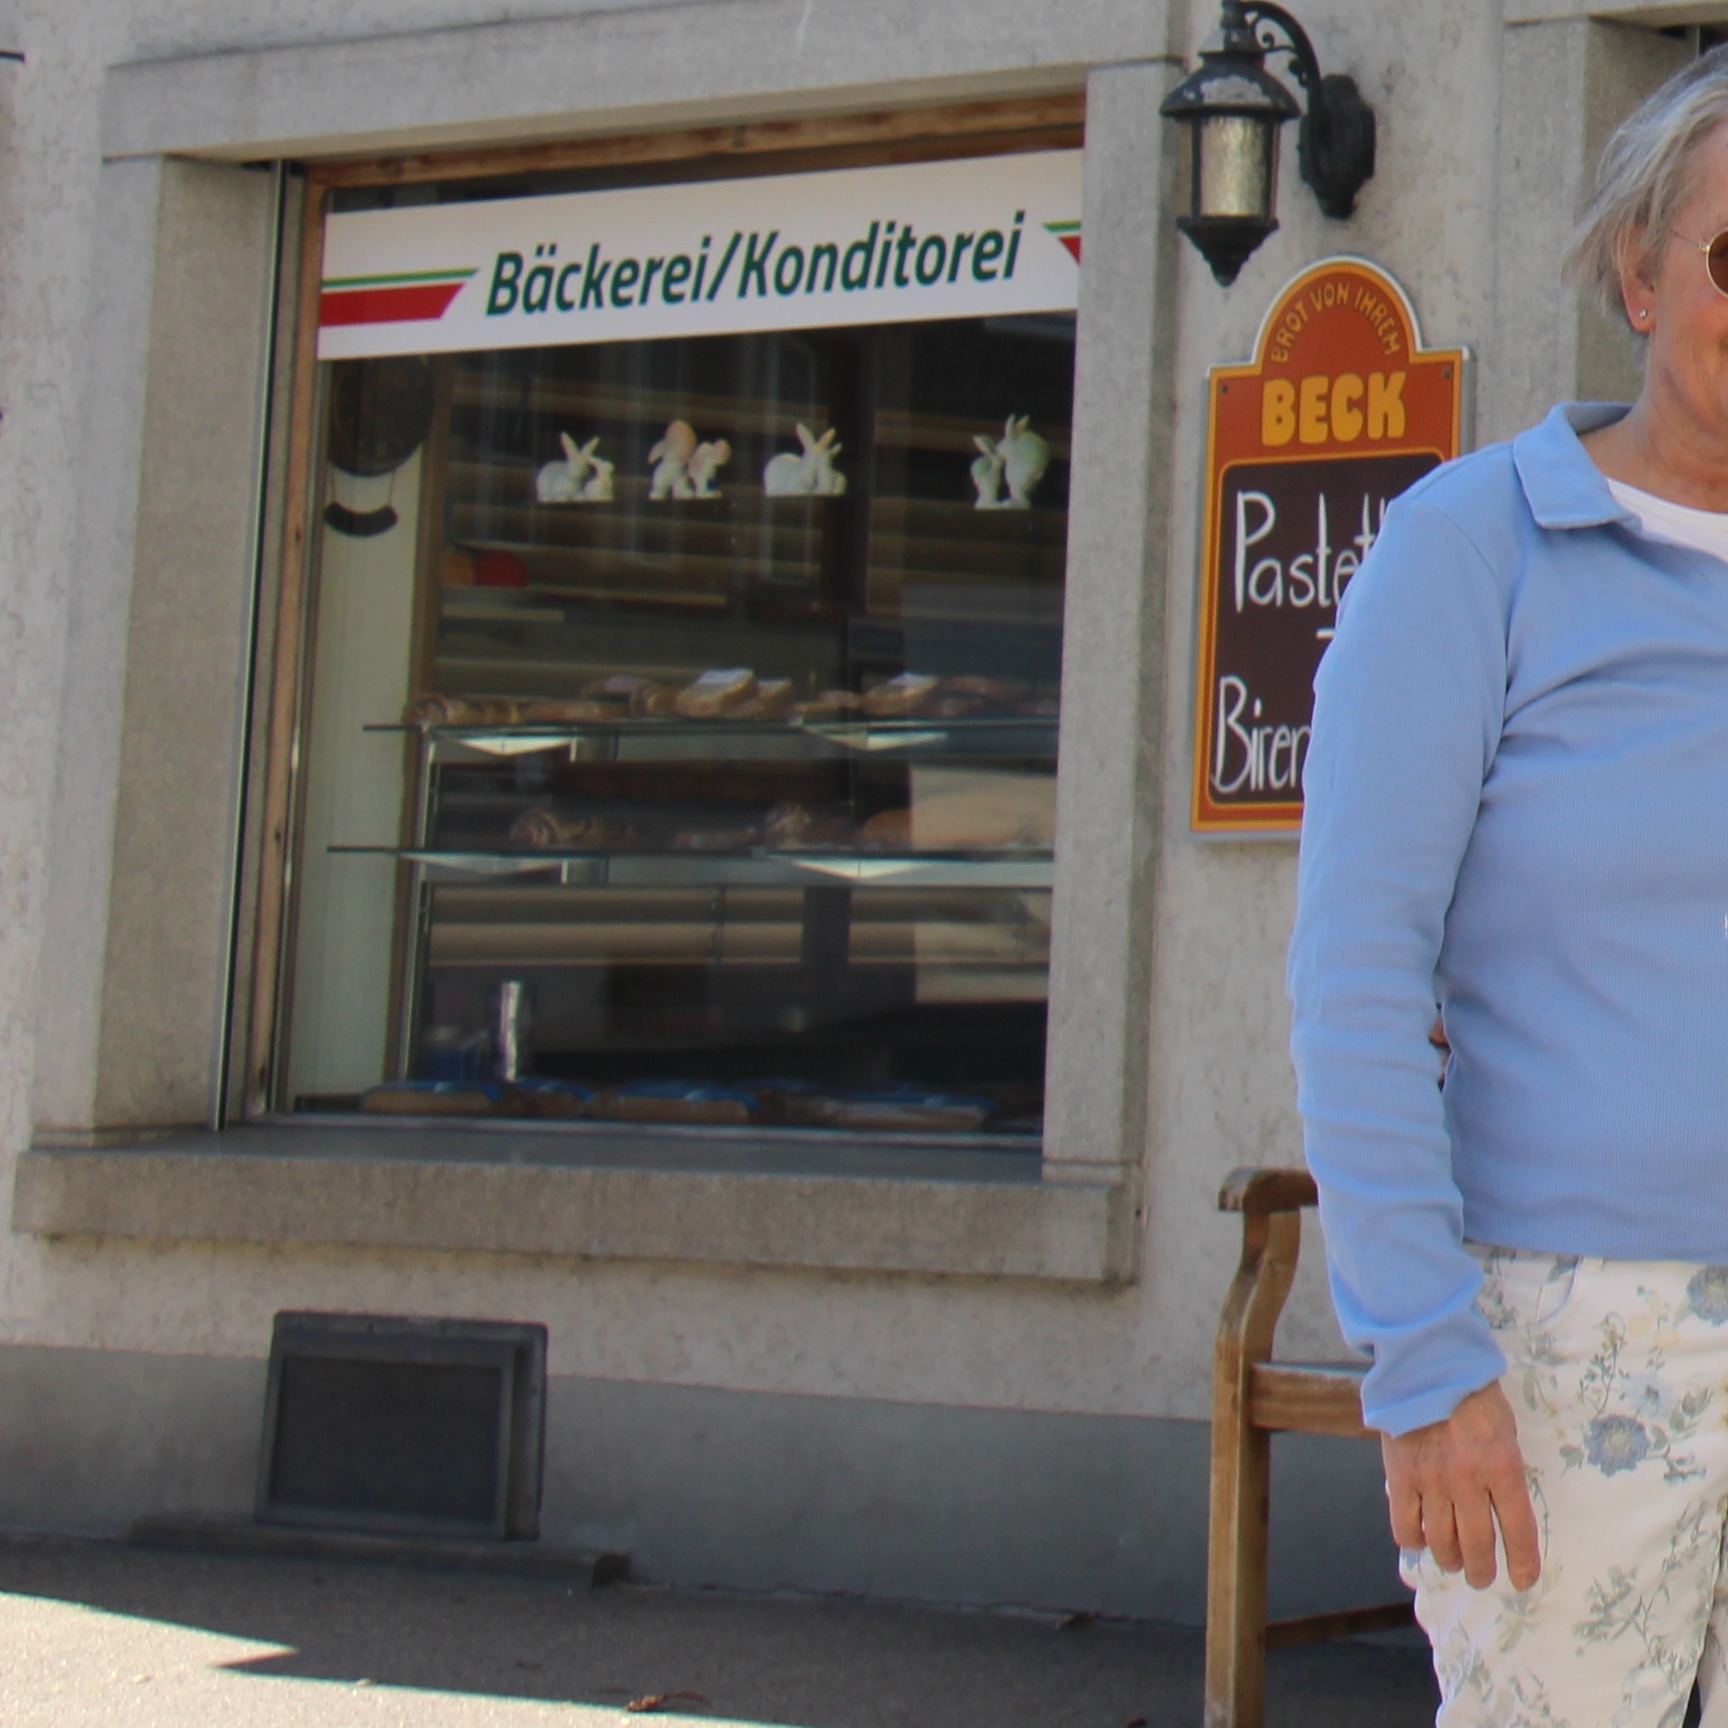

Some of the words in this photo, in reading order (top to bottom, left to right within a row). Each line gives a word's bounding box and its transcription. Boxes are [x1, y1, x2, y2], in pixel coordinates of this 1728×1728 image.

[485, 210, 1026, 317] Bäckerei/Konditorei
[1271, 300, 1308, 363] BROT
[1310, 282, 1350, 312] VON
[1354, 286, 1401, 355] IHREM
[1262, 372, 1406, 447] BECK
